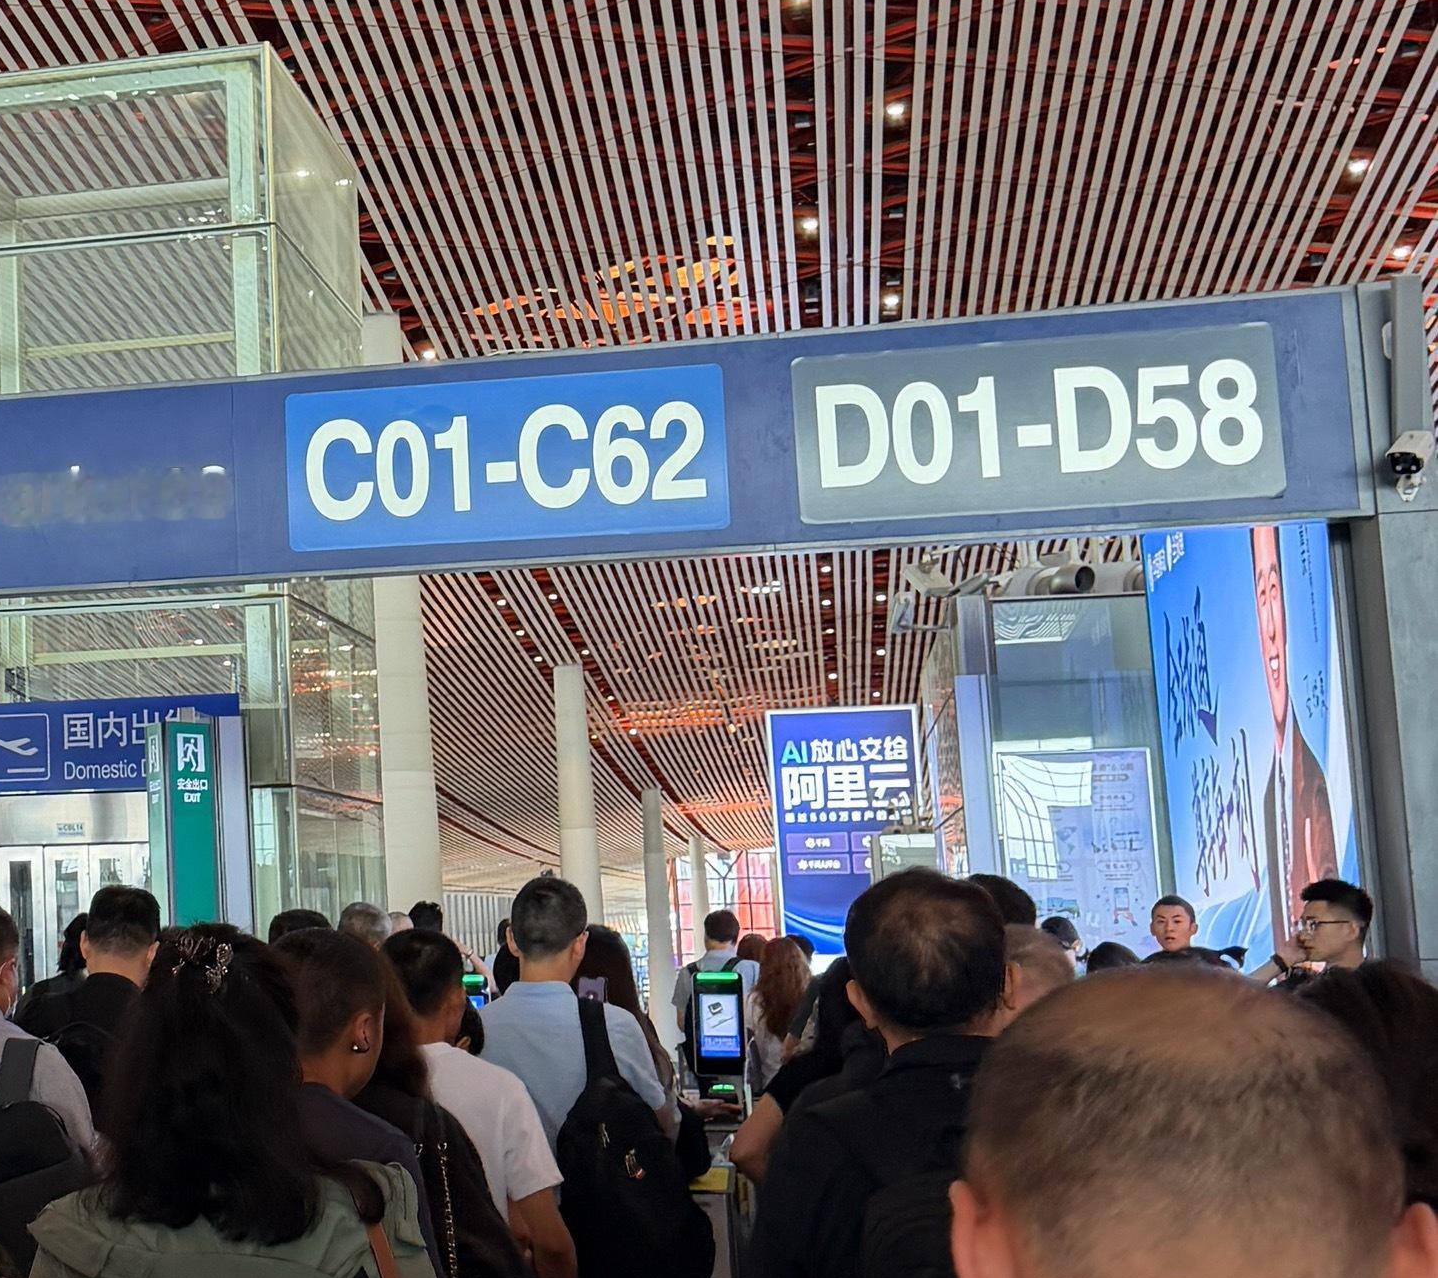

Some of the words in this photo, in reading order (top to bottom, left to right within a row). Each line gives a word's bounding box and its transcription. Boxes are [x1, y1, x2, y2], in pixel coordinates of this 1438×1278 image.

[815, 358, 1264, 489] D01-D58
[305, 400, 708, 522] C01-C62
[63, 706, 182, 752] 国内出
[64, 758, 137, 781] Domestic
[176, 777, 209, 791] 安全出口
[183, 792, 202, 803] EXIT
